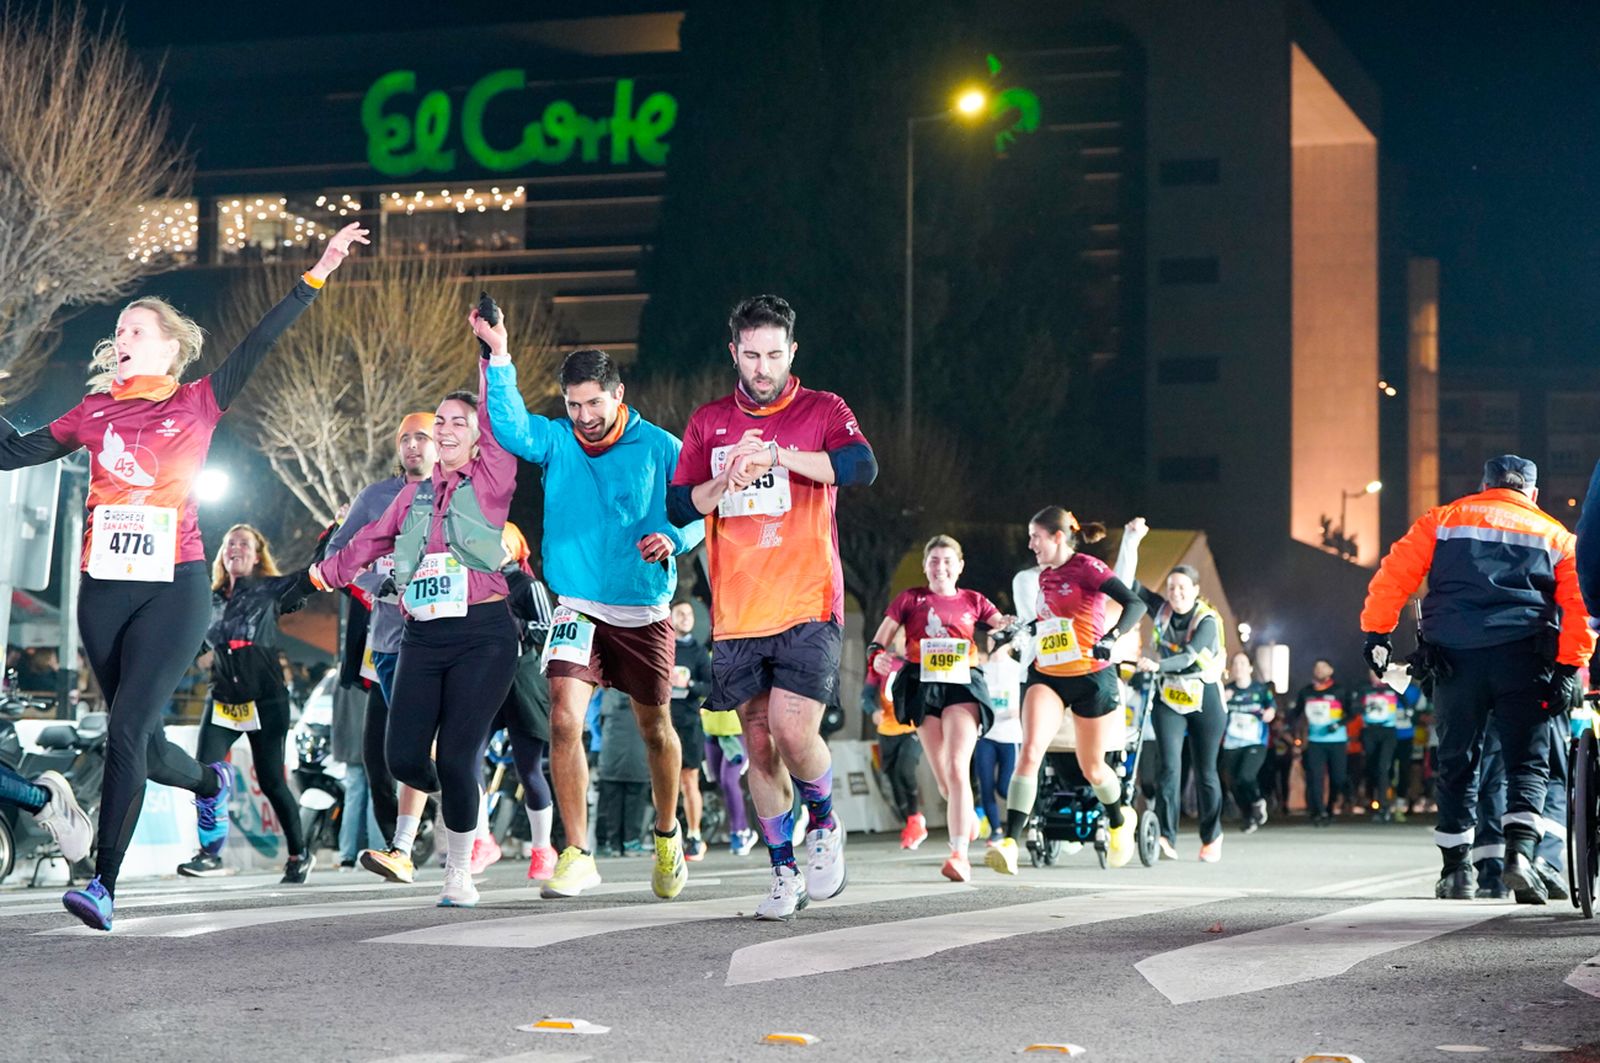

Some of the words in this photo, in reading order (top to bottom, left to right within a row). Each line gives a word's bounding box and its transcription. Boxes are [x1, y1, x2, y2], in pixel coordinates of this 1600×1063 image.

[361, 70, 455, 175] El
[461, 68, 678, 170] Corte
[114, 458, 135, 477] 43
[110, 532, 154, 556] 4778
[413, 575, 451, 600] 7739
[1042, 632, 1068, 650] 2306
